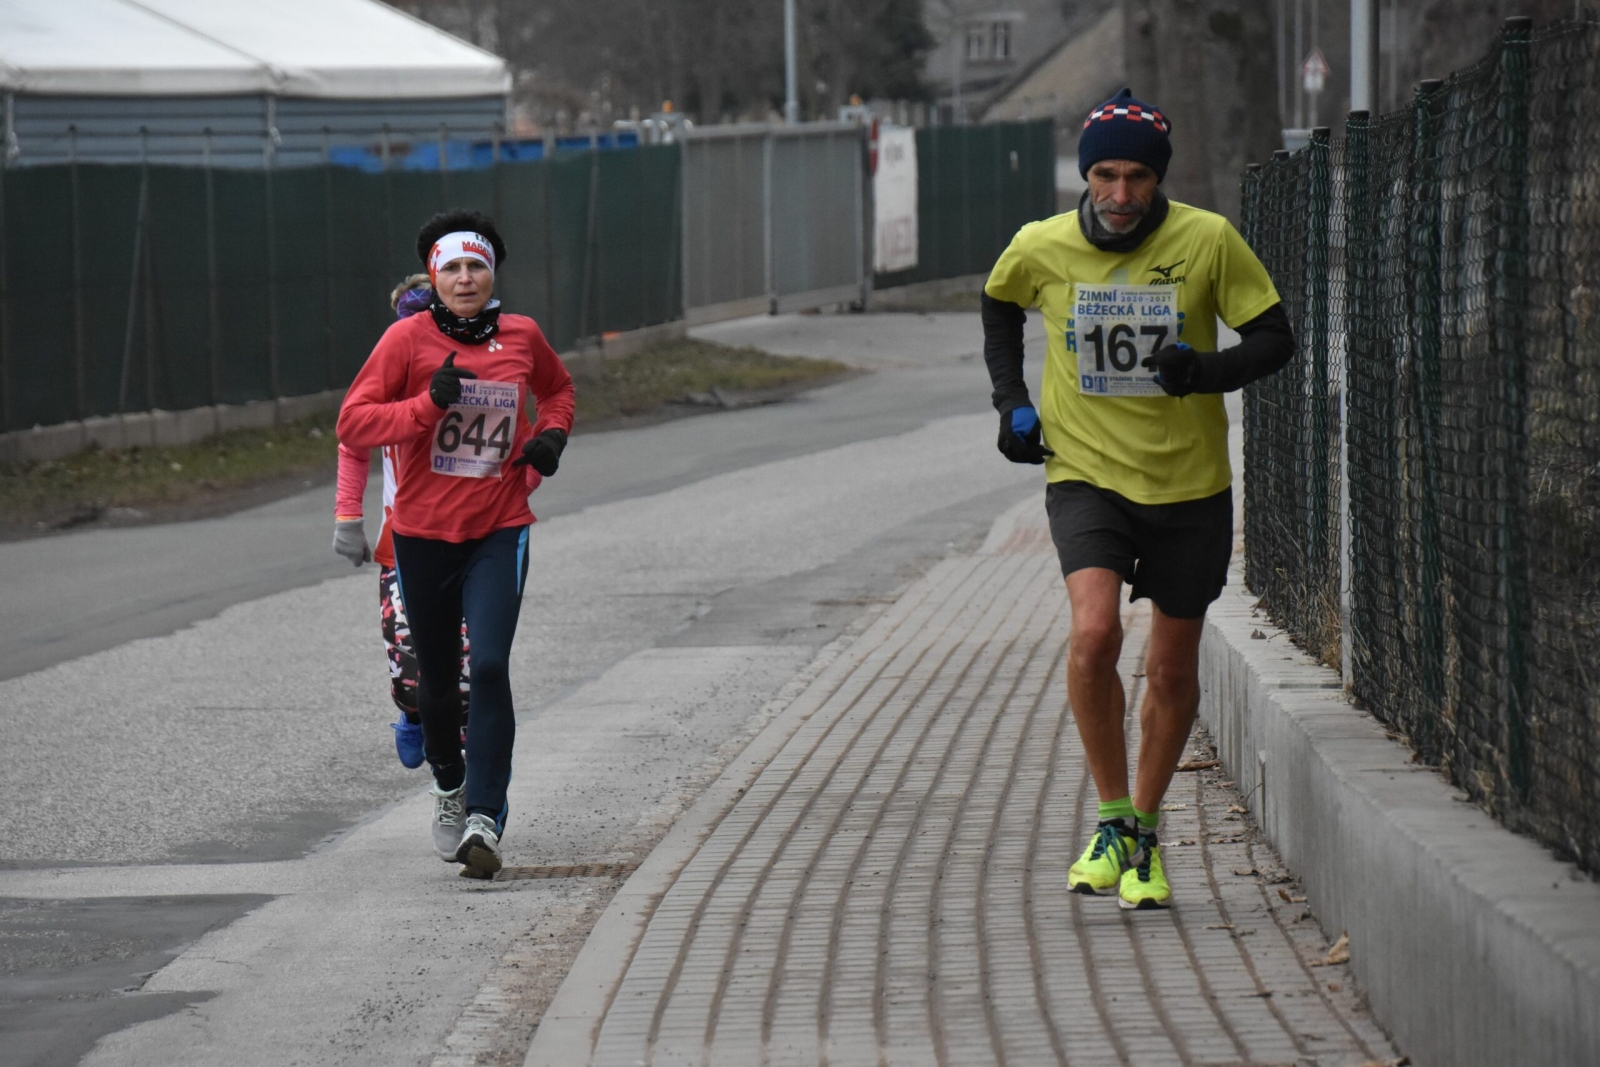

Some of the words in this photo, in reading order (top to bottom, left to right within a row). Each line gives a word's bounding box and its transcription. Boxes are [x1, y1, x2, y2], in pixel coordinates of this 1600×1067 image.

[1079, 289, 1117, 302] ZIMNÍ
[1078, 303, 1135, 316] BĚŽECKÁ
[1141, 305, 1171, 316] LIGA
[1084, 323, 1168, 373] 167
[494, 398, 516, 409] LIGA
[437, 411, 511, 459] 644
